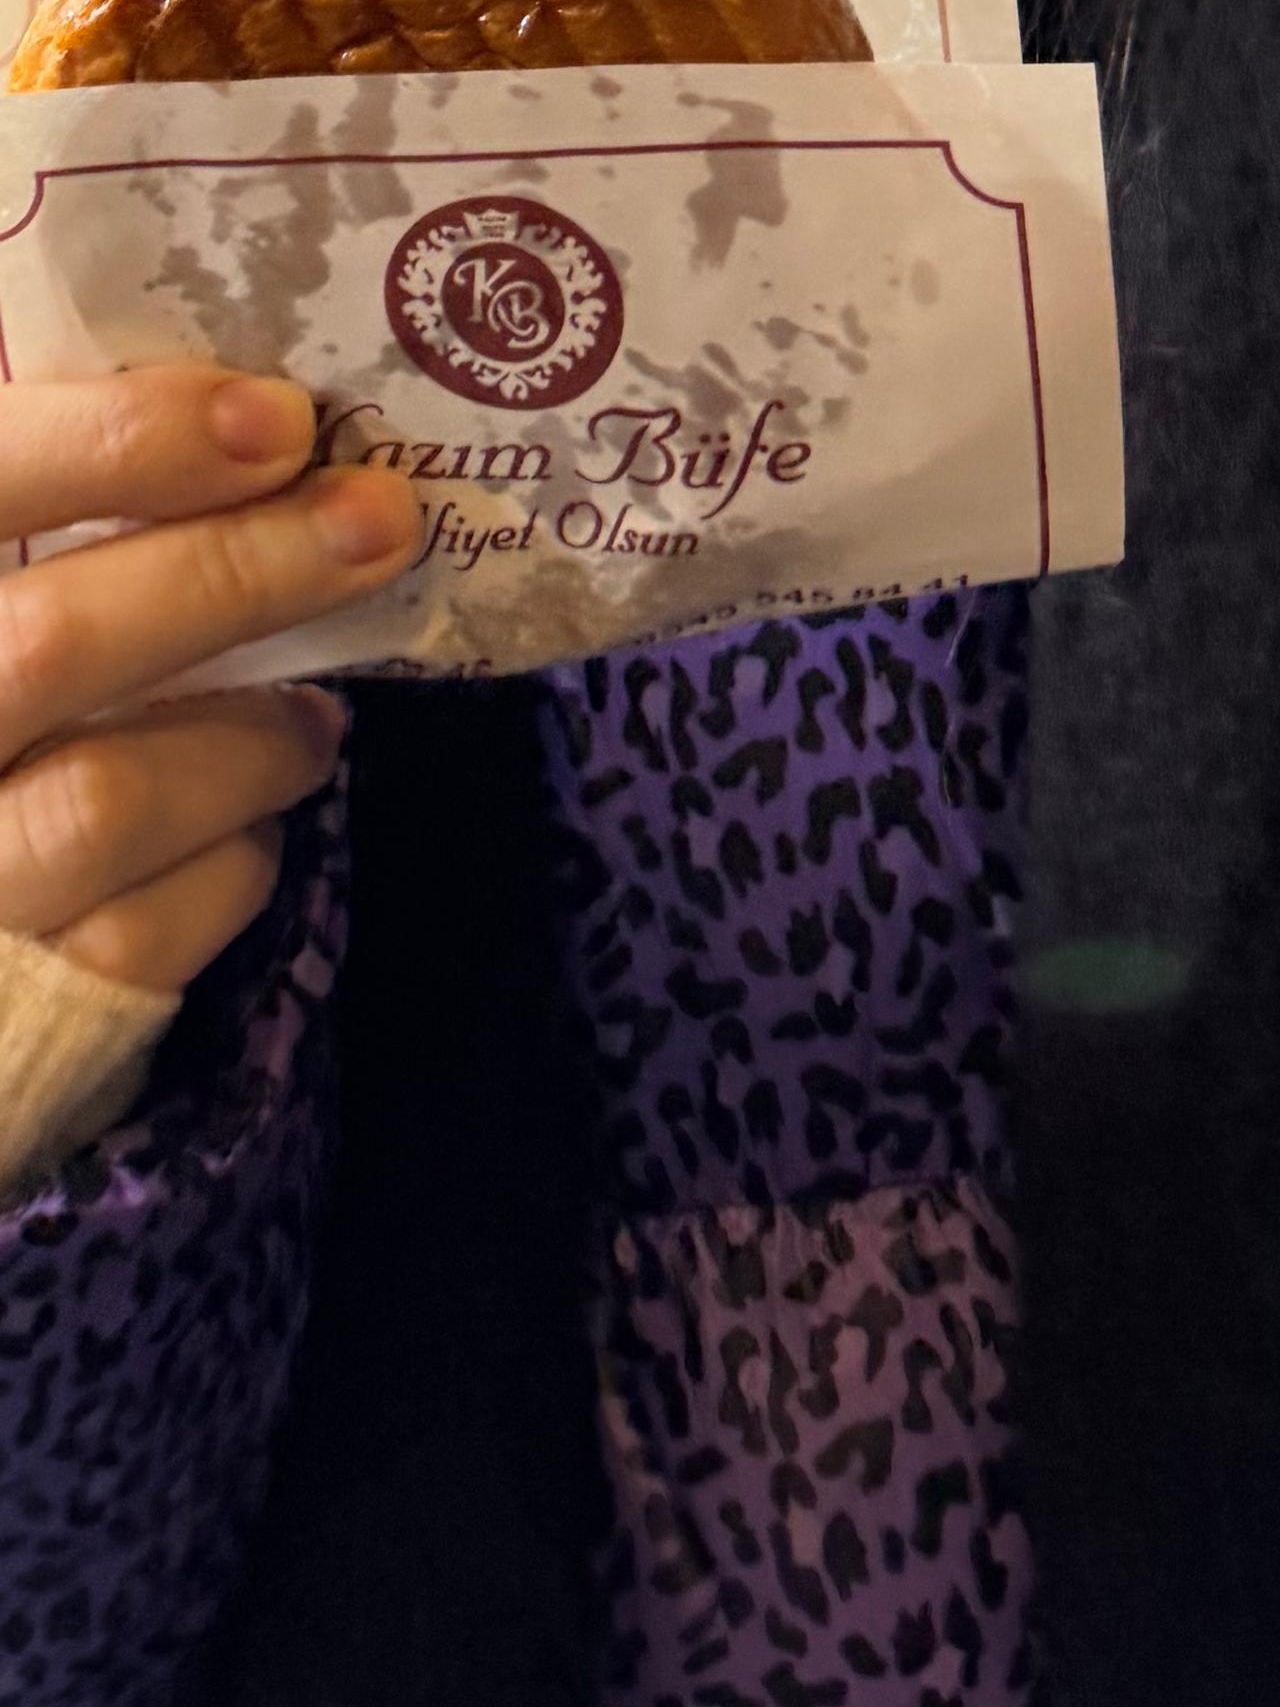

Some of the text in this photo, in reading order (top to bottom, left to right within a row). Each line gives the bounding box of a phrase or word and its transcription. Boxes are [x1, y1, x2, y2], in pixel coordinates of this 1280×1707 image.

[575, 399, 812, 520] Büfe
[412, 499, 700, 572] fiyet Olsun
